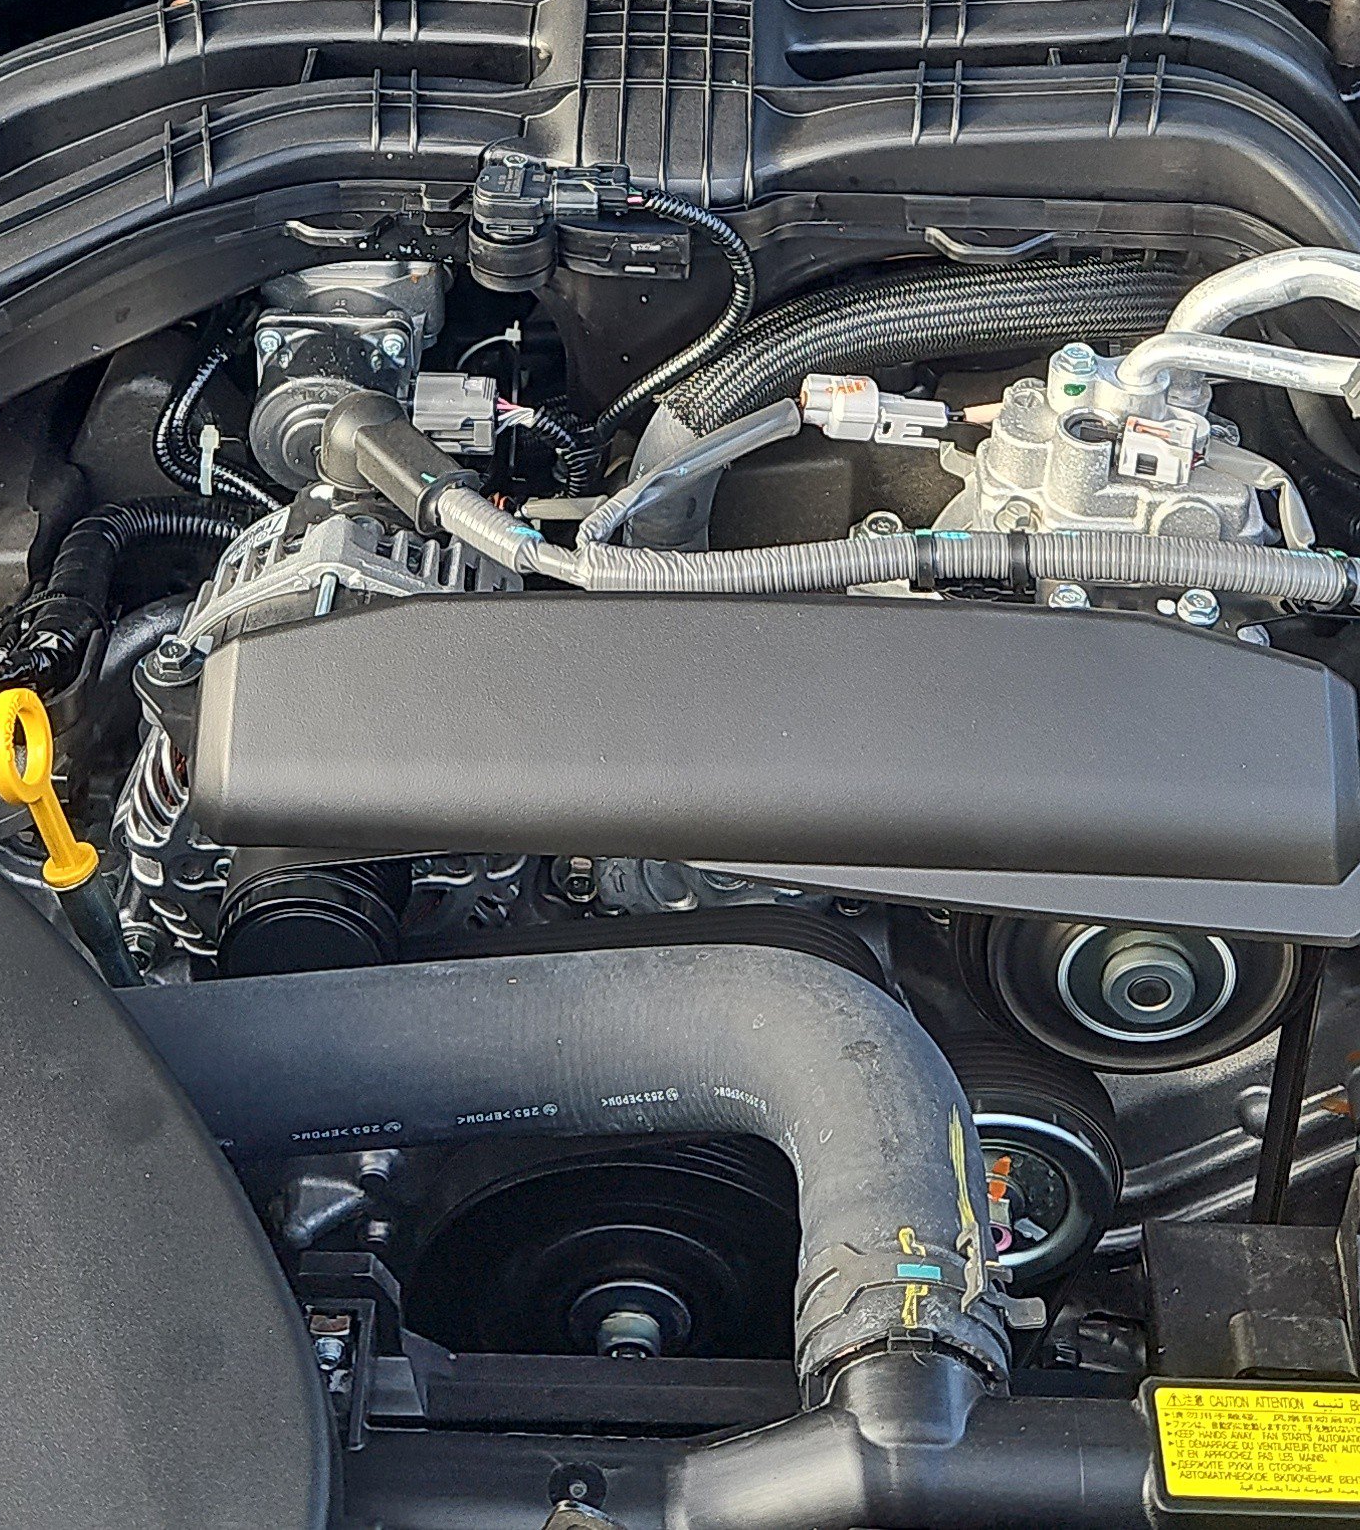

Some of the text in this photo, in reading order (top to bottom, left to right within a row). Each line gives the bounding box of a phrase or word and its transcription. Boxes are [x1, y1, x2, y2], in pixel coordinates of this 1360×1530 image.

[1210, 1395, 1249, 1408] CAUTION
[1256, 1396, 1304, 1409] ATTENTION
[1174, 1430, 1194, 1438] KEEP
[1200, 1431, 1227, 1439] HANDS
[1262, 1432, 1278, 1440] FAN
[1282, 1433, 1313, 1442] STARTS
